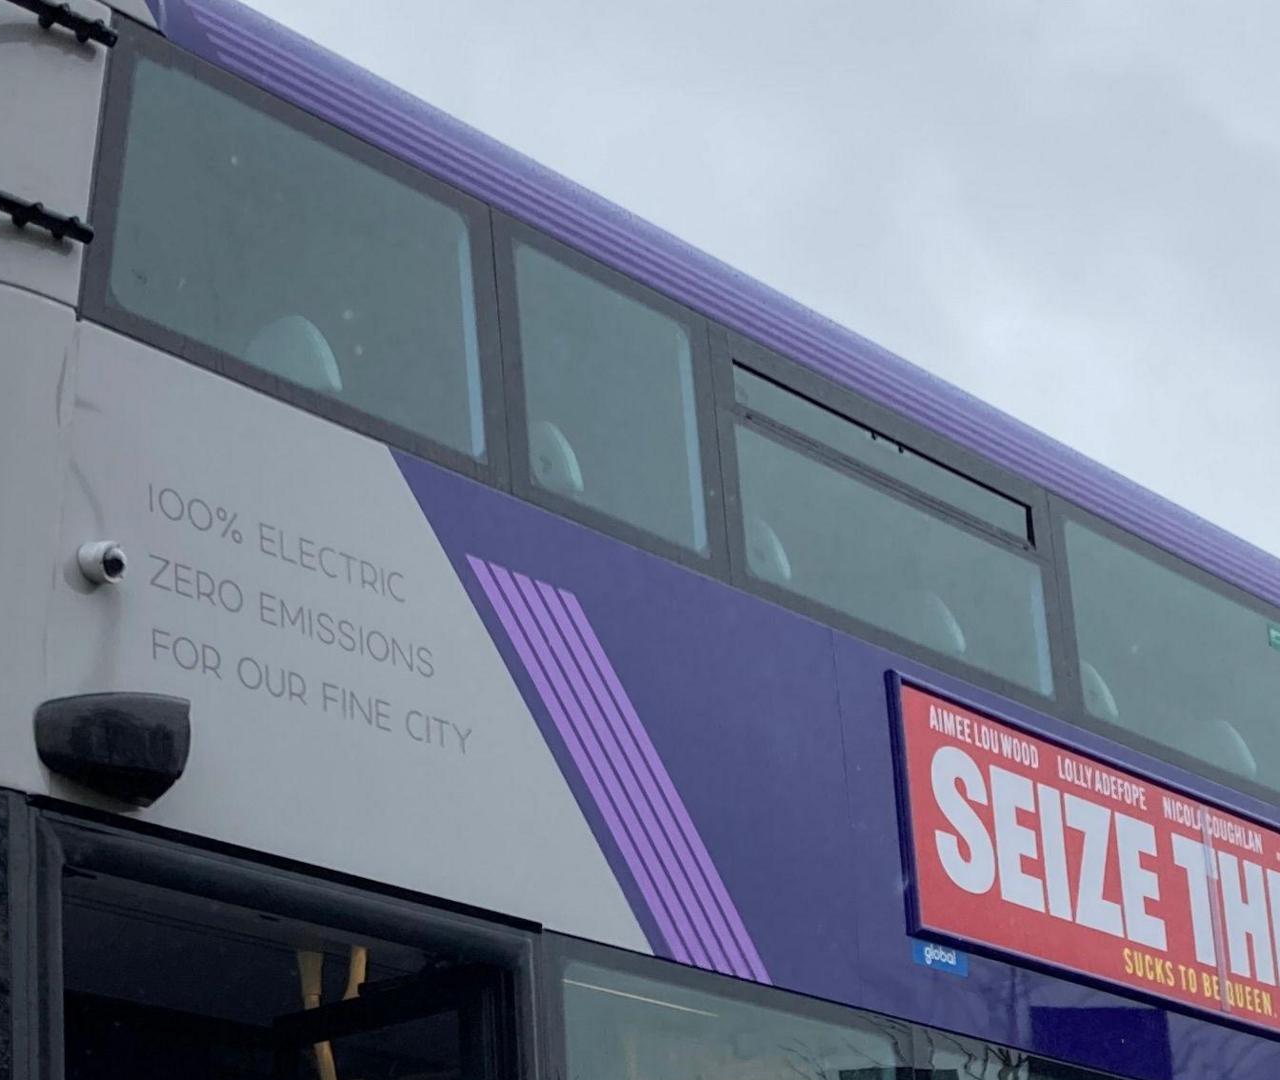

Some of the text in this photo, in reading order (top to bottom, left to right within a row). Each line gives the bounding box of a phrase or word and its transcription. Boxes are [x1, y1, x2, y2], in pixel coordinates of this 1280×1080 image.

[148, 484, 407, 603] 100% ELECTRIC
[148, 554, 436, 679] ZERO EMISSIONS
[151, 628, 473, 755] FOR OUR FINE CITY
[929, 705, 1039, 769] AIMEE LOU WOOD
[1057, 755, 1148, 811] LOLLY ADEFOPE
[931, 745, 1168, 951] SEIZE
[1162, 796, 1263, 854] NICOLA COUGHLAN
[925, 943, 957, 965] global
[1123, 947, 1279, 1018] SUCKS TO BE QUEEN.
